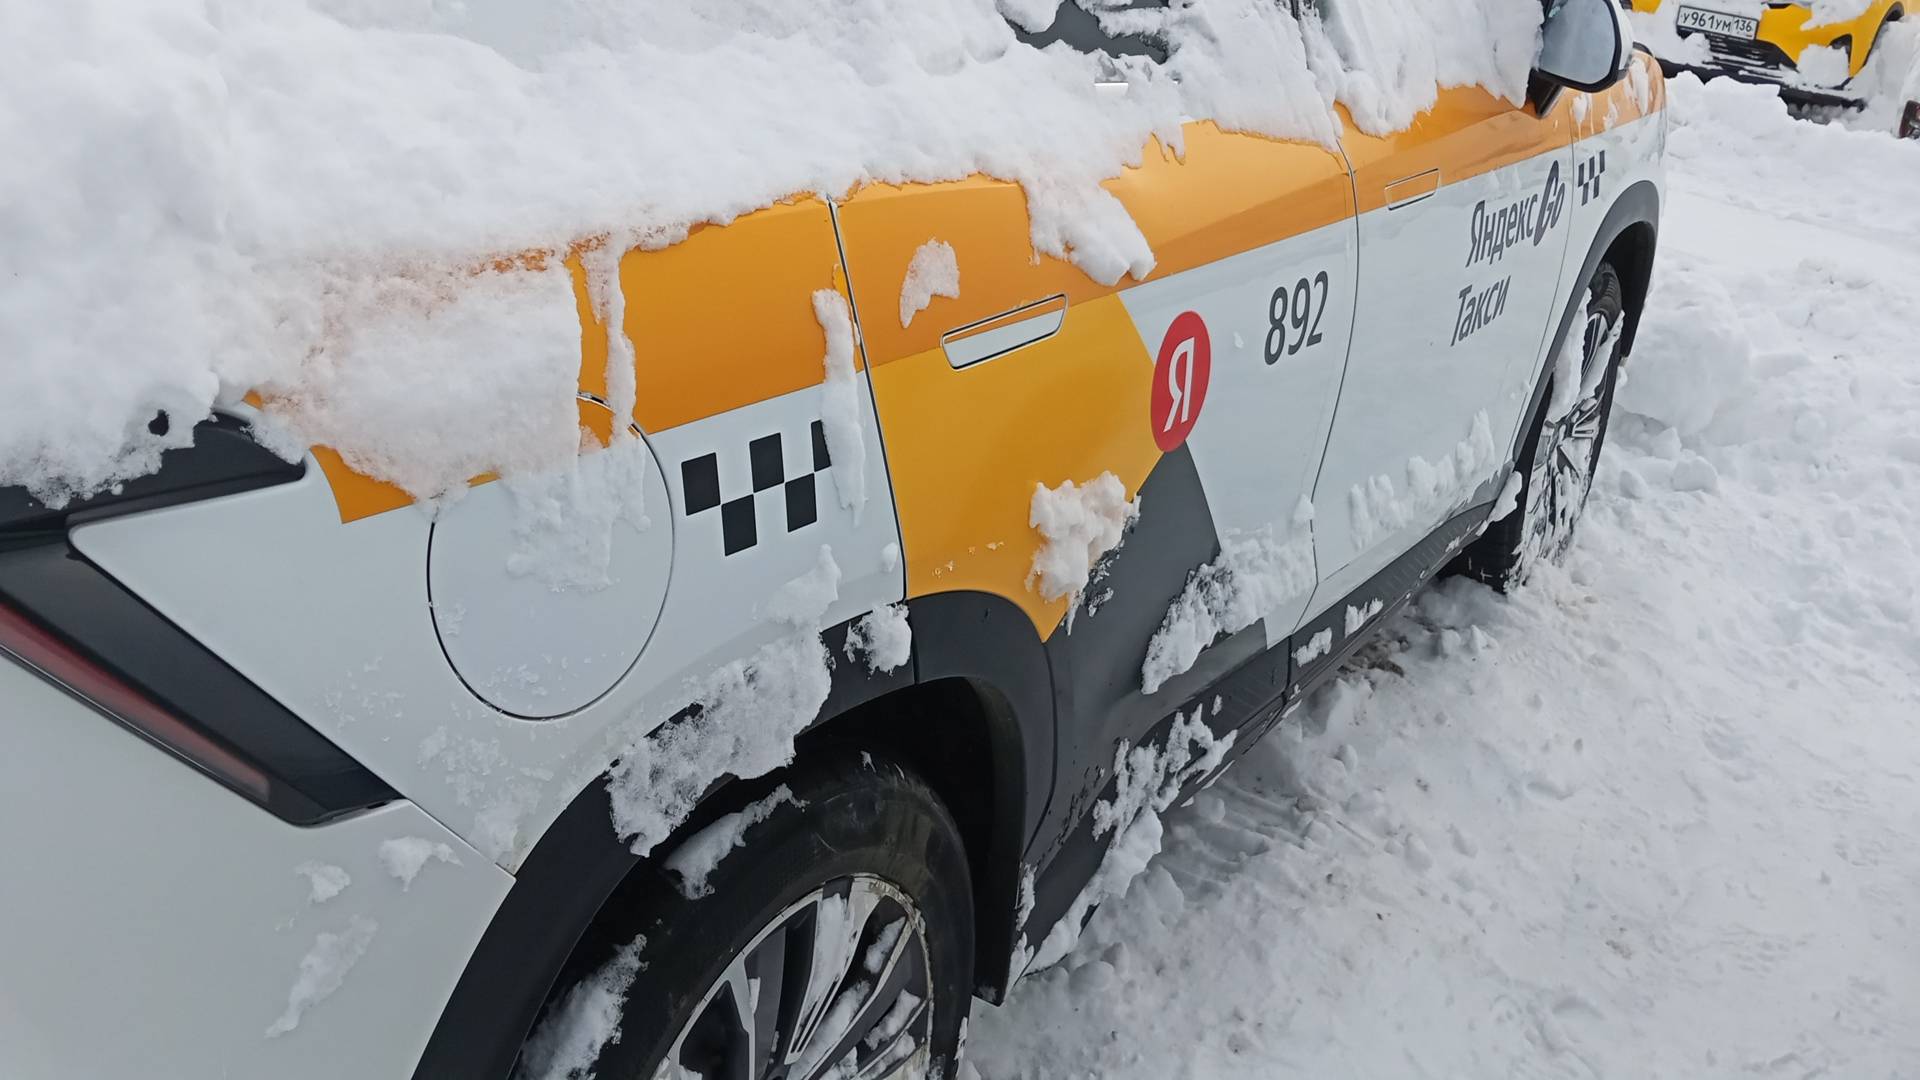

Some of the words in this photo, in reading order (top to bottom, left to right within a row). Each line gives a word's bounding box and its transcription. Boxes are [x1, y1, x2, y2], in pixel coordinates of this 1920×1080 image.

[1734, 19, 1752, 32] 136
[1465, 193, 1539, 268] Яндекс
[1533, 160, 1565, 247] Go
[1264, 270, 1329, 366] 892
[1451, 275, 1511, 347] Такси
[1163, 336, 1195, 433] Я
